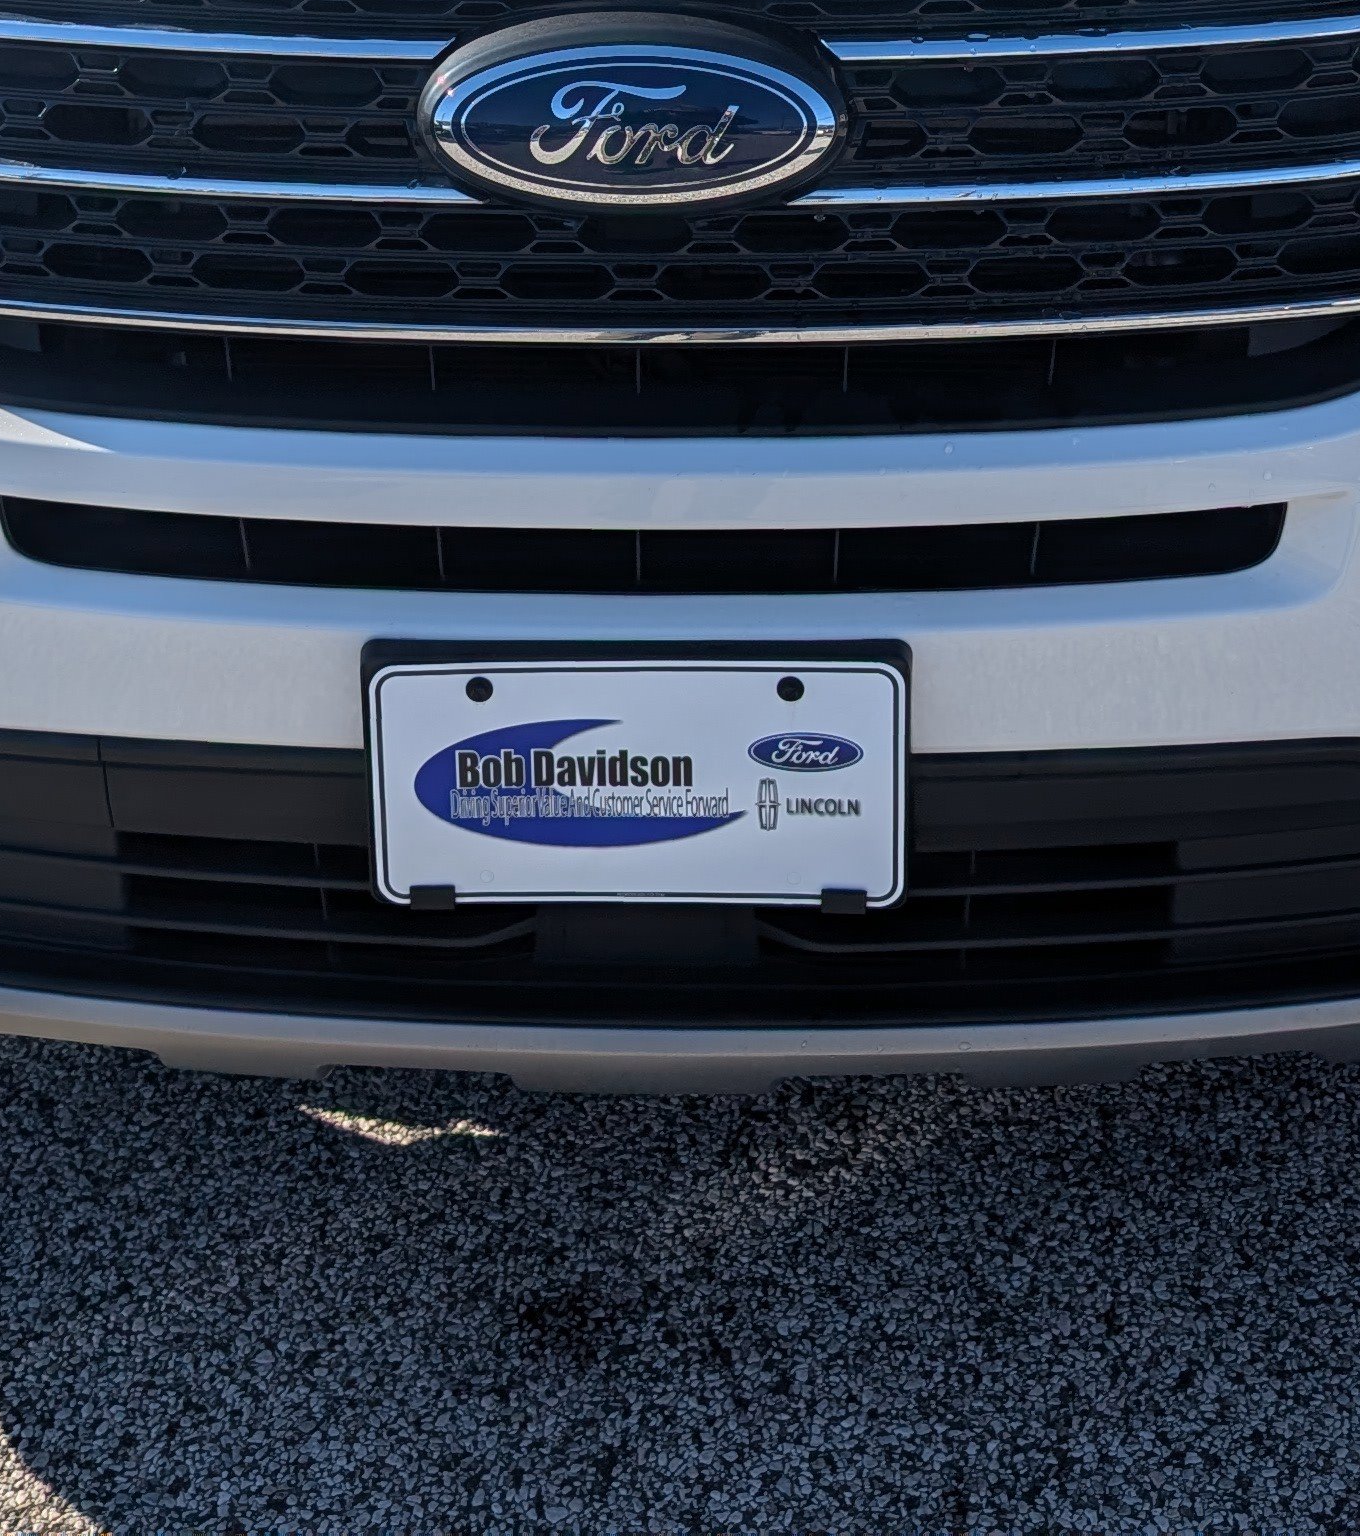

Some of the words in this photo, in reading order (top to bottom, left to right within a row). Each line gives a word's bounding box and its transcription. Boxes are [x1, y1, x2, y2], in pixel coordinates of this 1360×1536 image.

[528, 79, 741, 166] Ford
[455, 749, 525, 789] Bob
[531, 749, 693, 788] Davidson
[771, 738, 840, 765] Ford
[450, 788, 490, 826] Driving
[491, 788, 536, 825] Superior
[536, 787, 568, 817] Value
[568, 787, 592, 817] And
[593, 788, 644, 817] Customer
[645, 787, 683, 817] Service
[685, 787, 729, 817] Forward
[786, 797, 861, 817] LINCOLN
